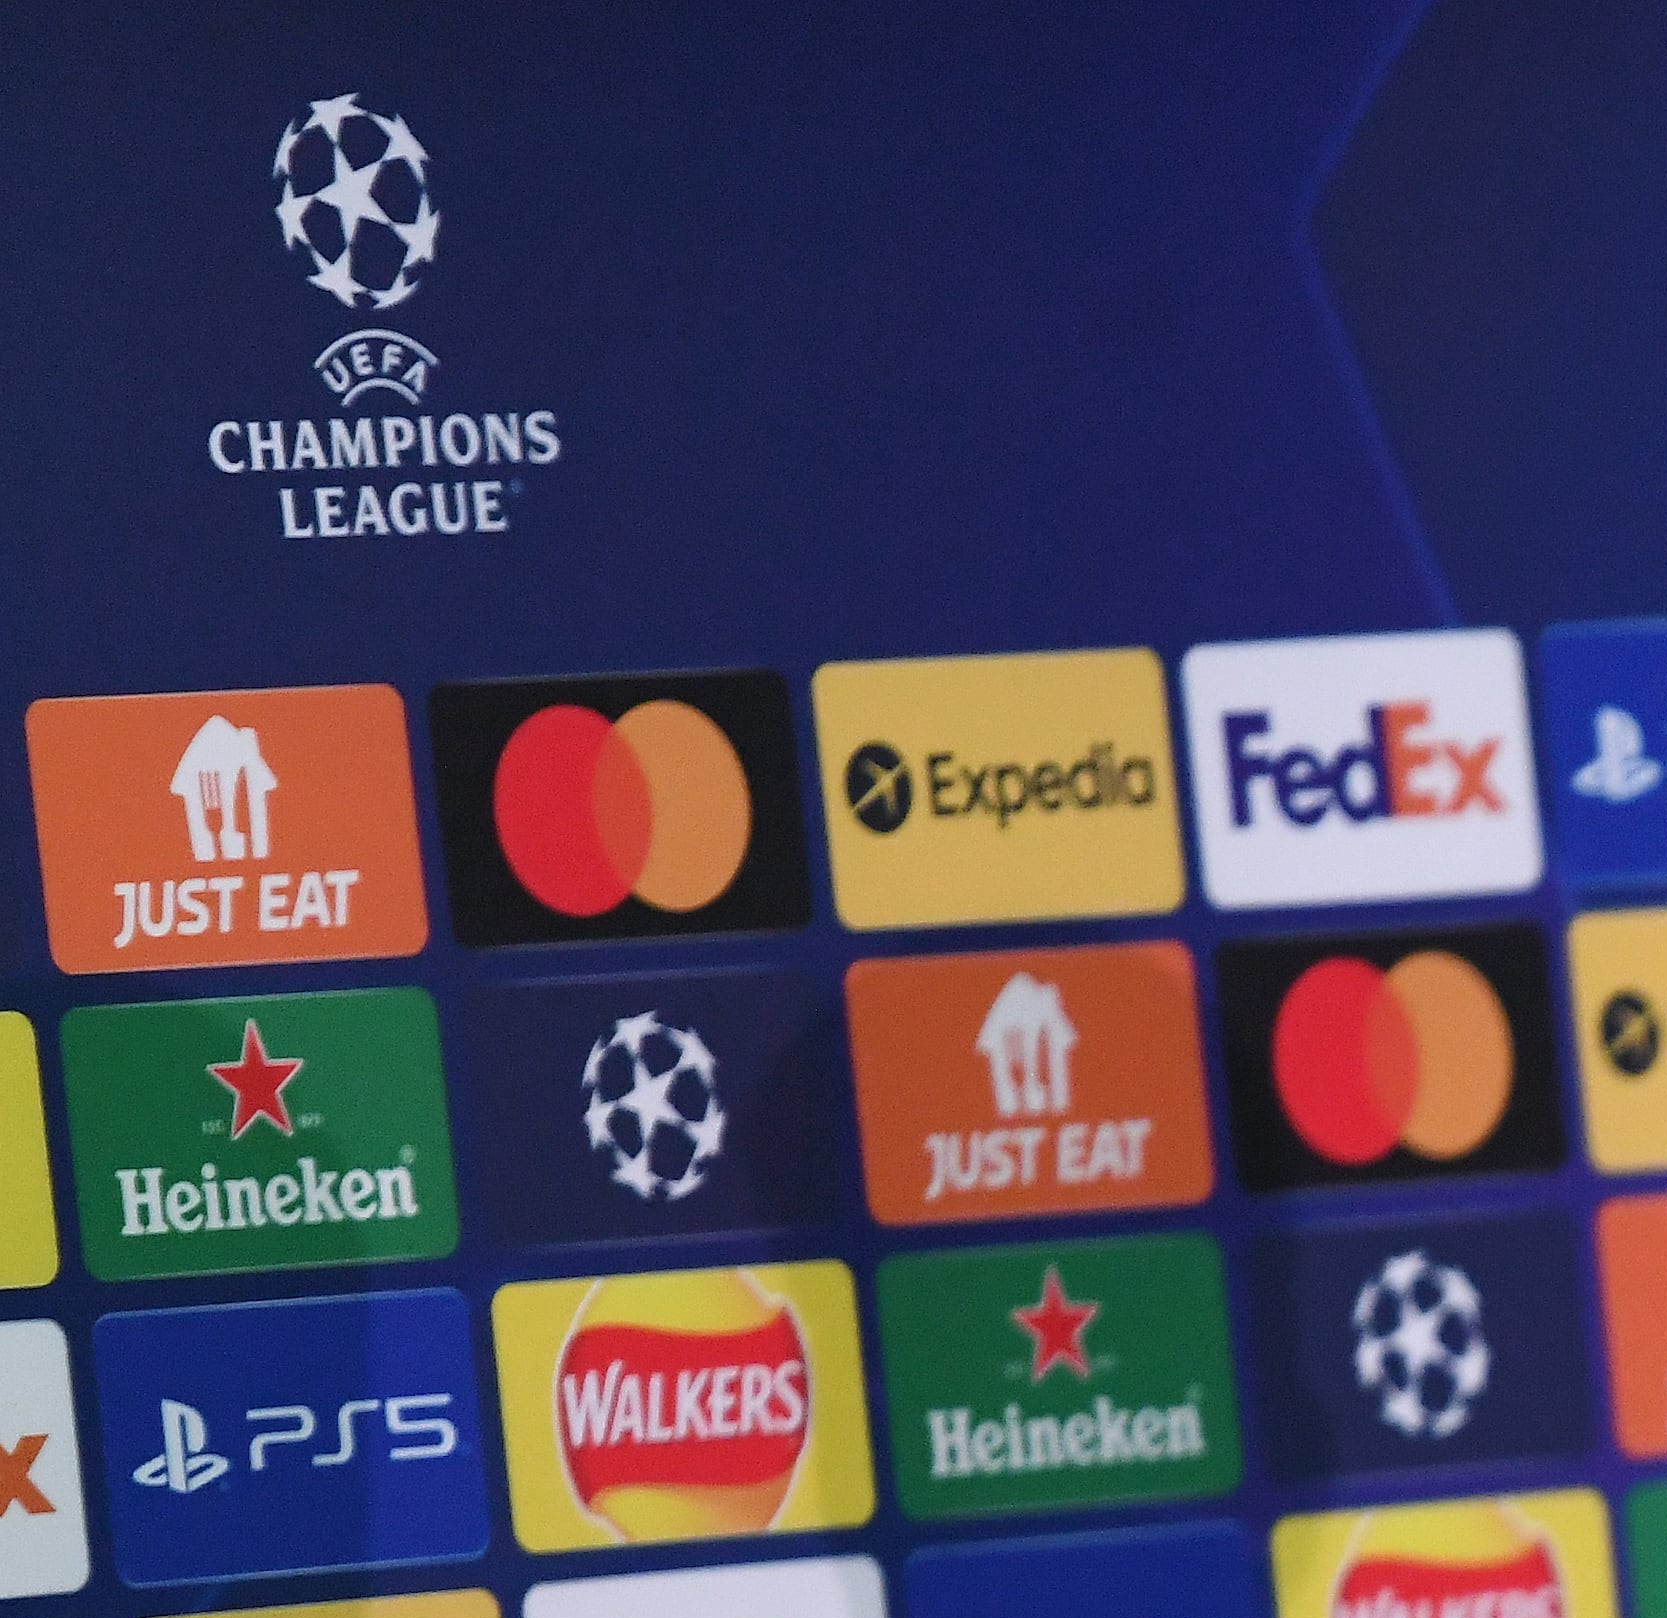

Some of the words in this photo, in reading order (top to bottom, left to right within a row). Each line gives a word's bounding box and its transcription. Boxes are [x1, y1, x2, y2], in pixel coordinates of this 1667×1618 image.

[321, 341, 428, 395] UEFA
[208, 411, 561, 473] CHAMPIONS
[280, 481, 508, 540] LEAGUE
[924, 741, 1157, 831] Expedia
[1221, 700, 1504, 830] FedEx
[114, 877, 244, 949] JUST
[258, 869, 360, 930] EAT
[116, 1156, 418, 1236] Heineken
[924, 1128, 1046, 1202] JUST
[1056, 1118, 1154, 1182] EAT
[246, 1392, 457, 1473] PS5
[561, 1357, 806, 1449] WALKERS
[926, 1395, 1204, 1481] Heineken
